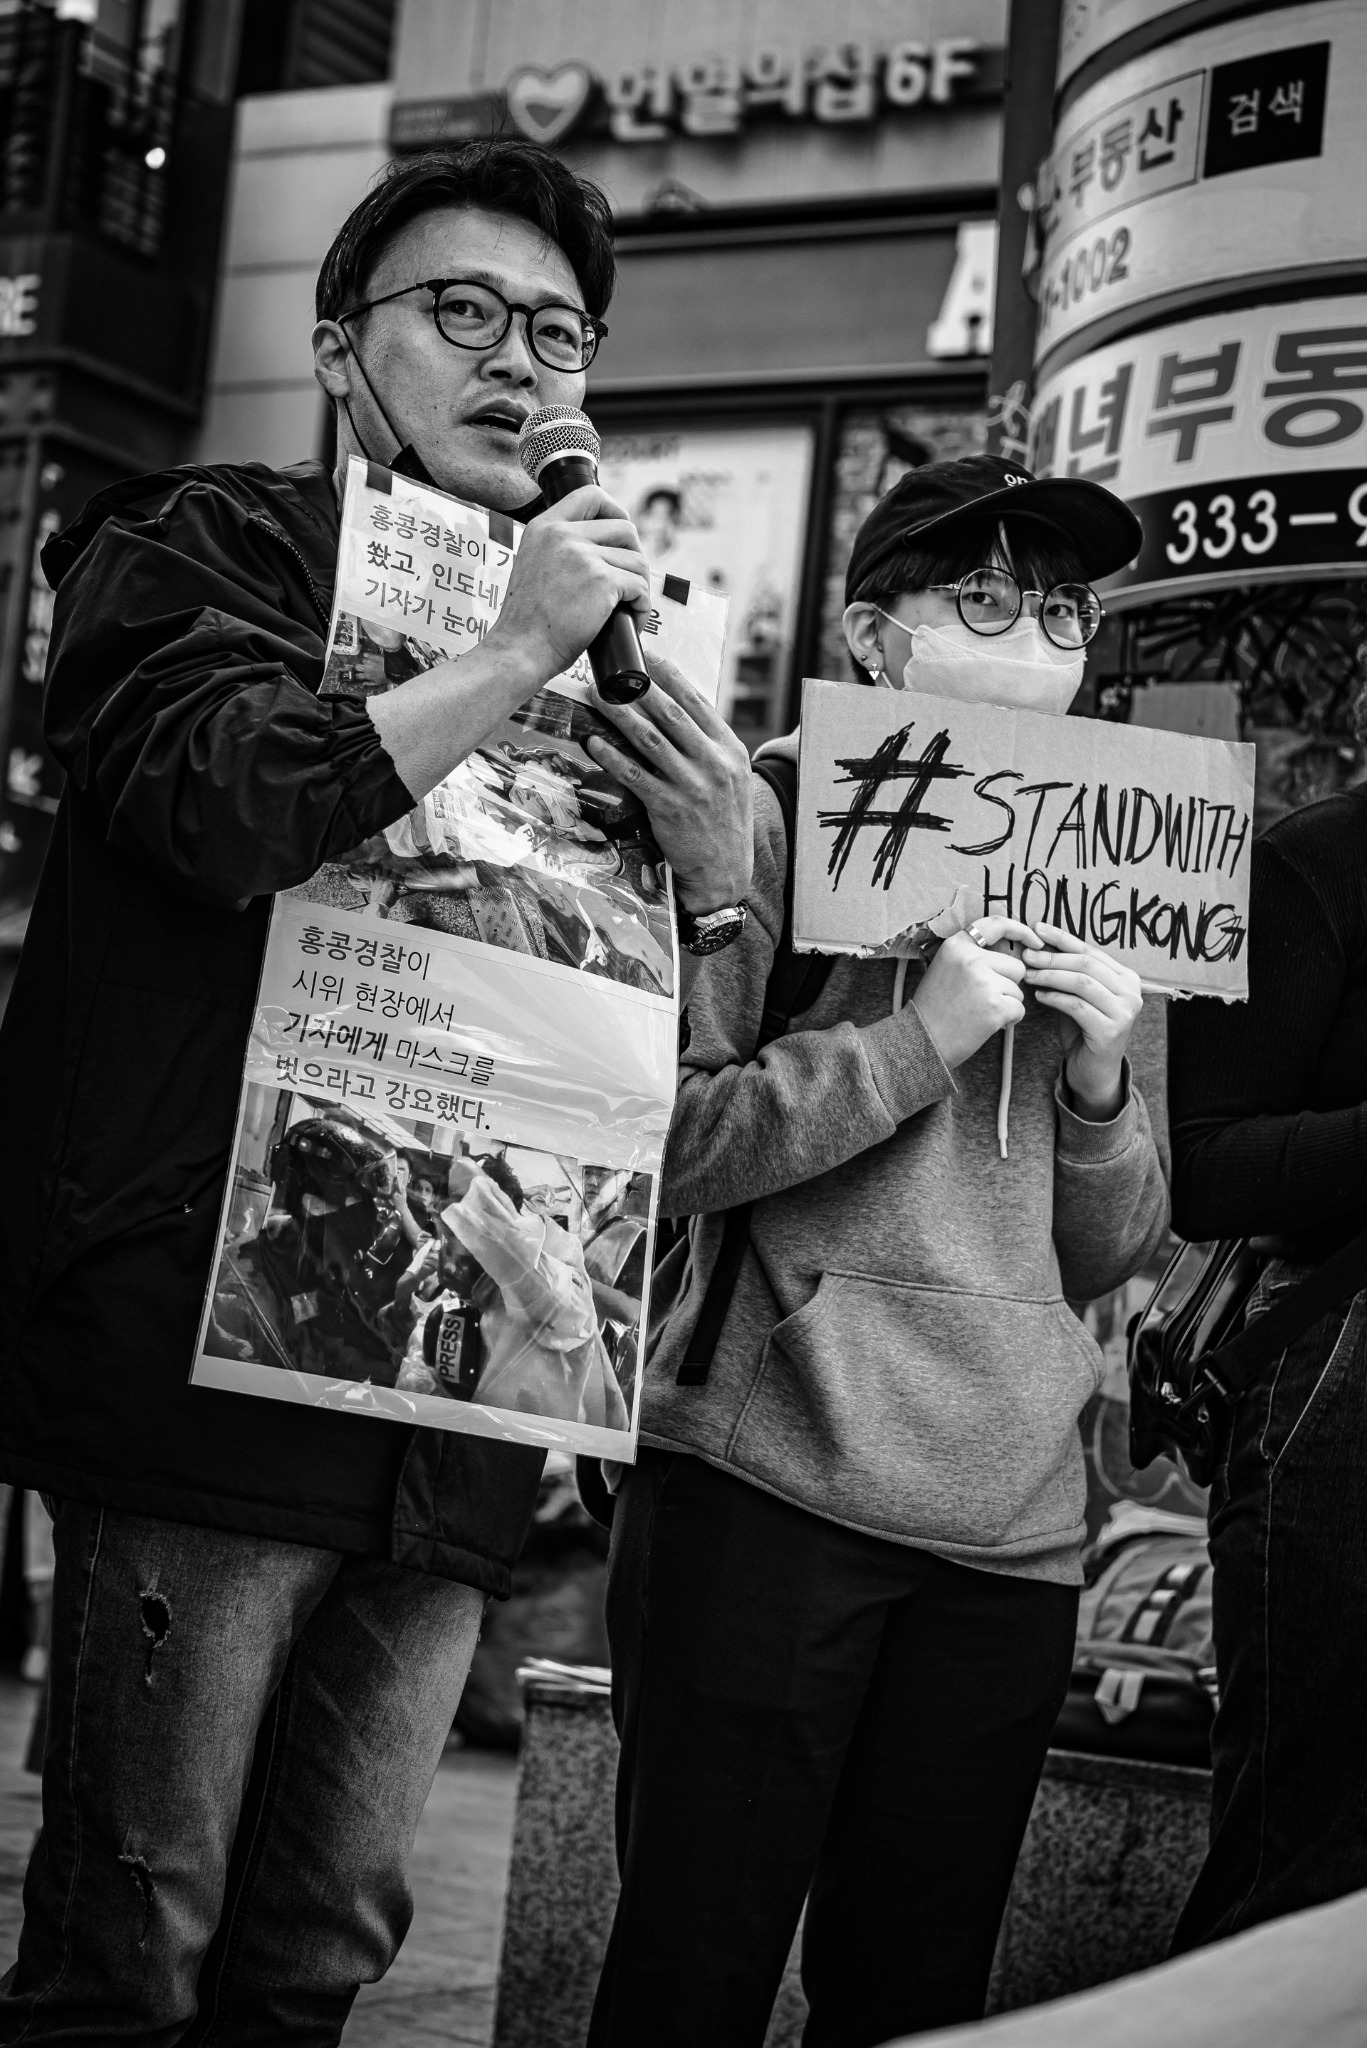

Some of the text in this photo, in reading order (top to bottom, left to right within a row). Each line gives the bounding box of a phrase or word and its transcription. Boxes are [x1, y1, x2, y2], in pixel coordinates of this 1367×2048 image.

[884, 38, 976, 105] 6F
[1228, 79, 1305, 137] 검색
[369, 504, 487, 566] 홍콩경찰이
[365, 578, 436, 625] 기자가
[432, 563, 503, 611] 인도네
[983, 863, 1247, 963] HONGKONG
[298, 925, 430, 981] 홍콩경찰이
[292, 969, 454, 1032] 시위 현장에서
[283, 1012, 495, 1087] 기자에게 마스크를
[275, 1054, 490, 1131] 벗으라고 강요했다.
[440, 1318, 461, 1379] PRESS
